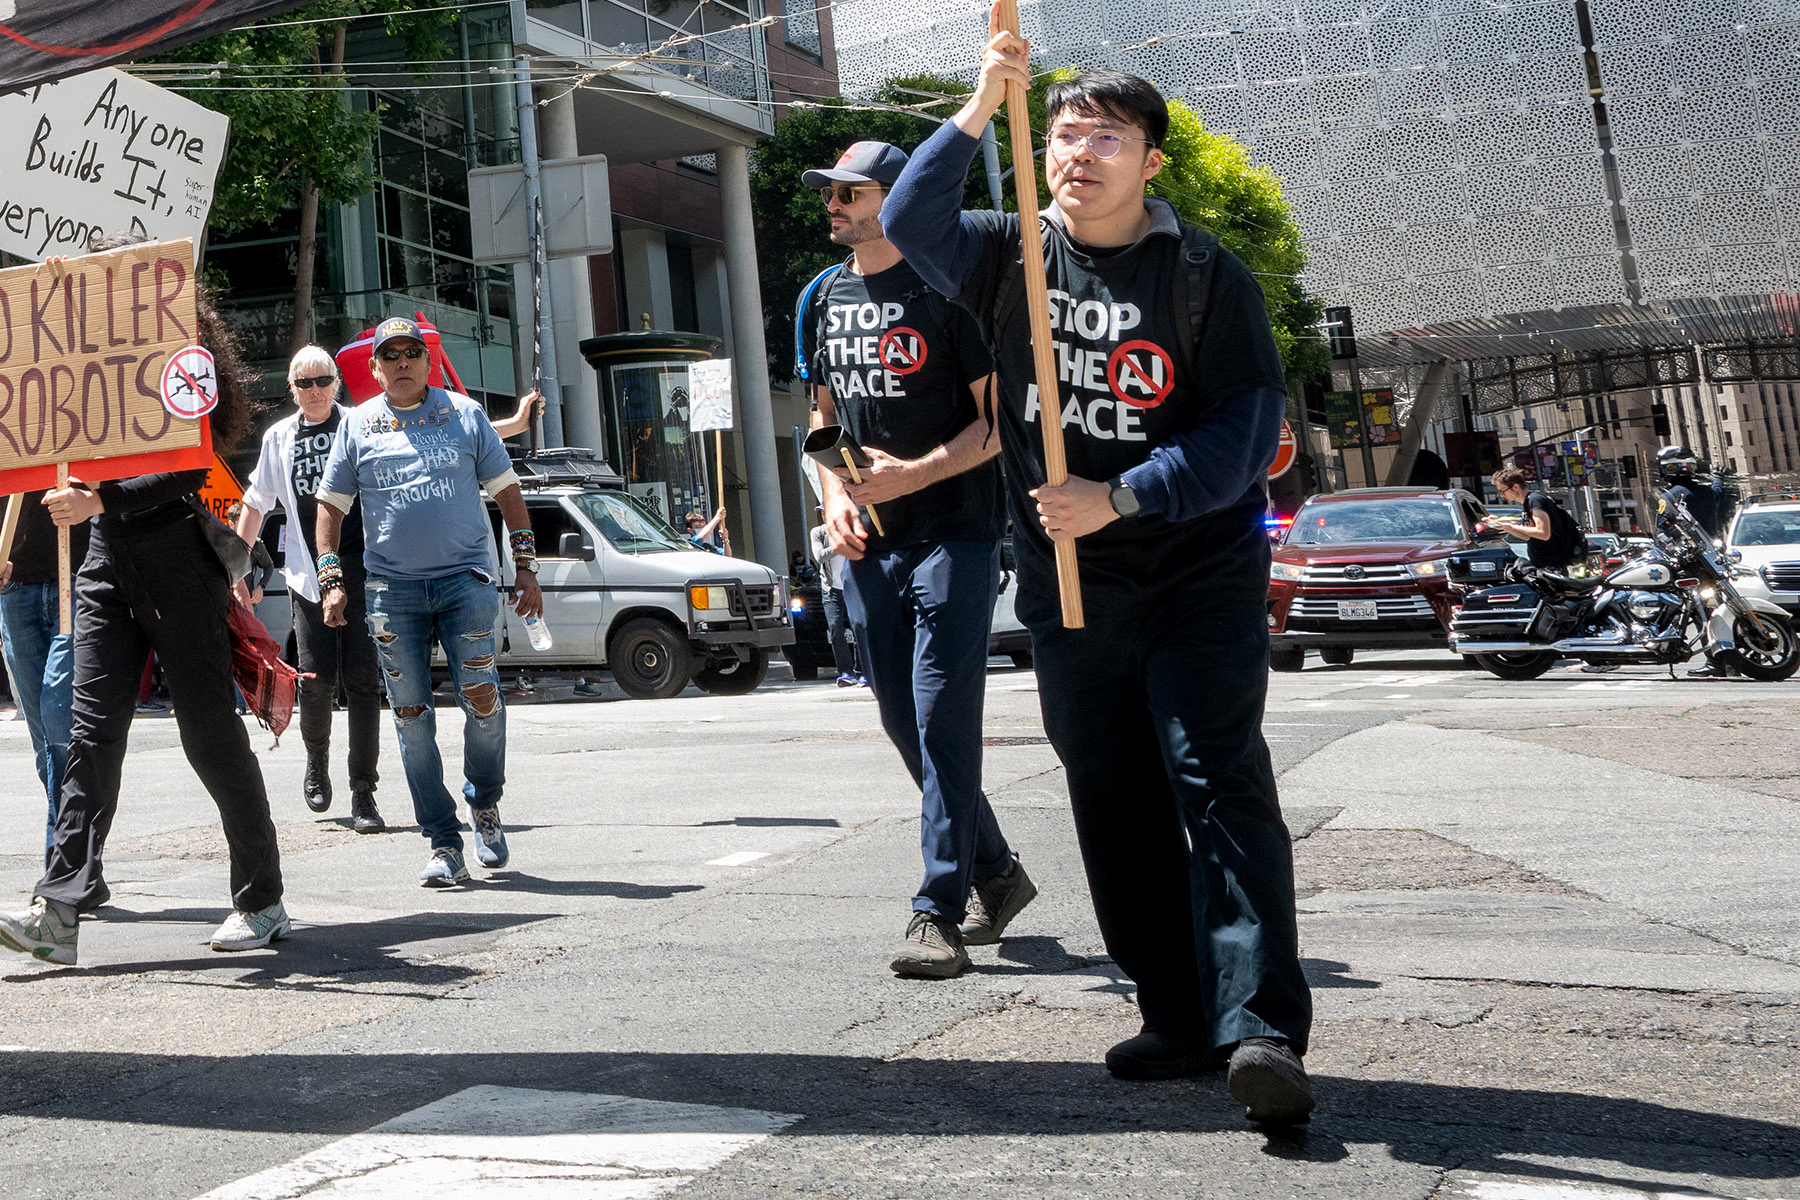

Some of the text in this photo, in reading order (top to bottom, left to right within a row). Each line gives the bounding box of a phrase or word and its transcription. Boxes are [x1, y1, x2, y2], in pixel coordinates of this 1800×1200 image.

[84, 78, 205, 165] Anyone
[26, 114, 173, 217] Builds It,
[185, 204, 202, 220] AI
[30, 256, 191, 364] KILLER
[826, 301, 905, 333] STOP
[825, 336, 919, 367] THE AI
[829, 368, 907, 399] RACE
[1117, 353, 1164, 395] AI
[409, 429, 449, 446] People
[423, 445, 460, 473] HAD
[390, 476, 456, 510] ENOUGH!
